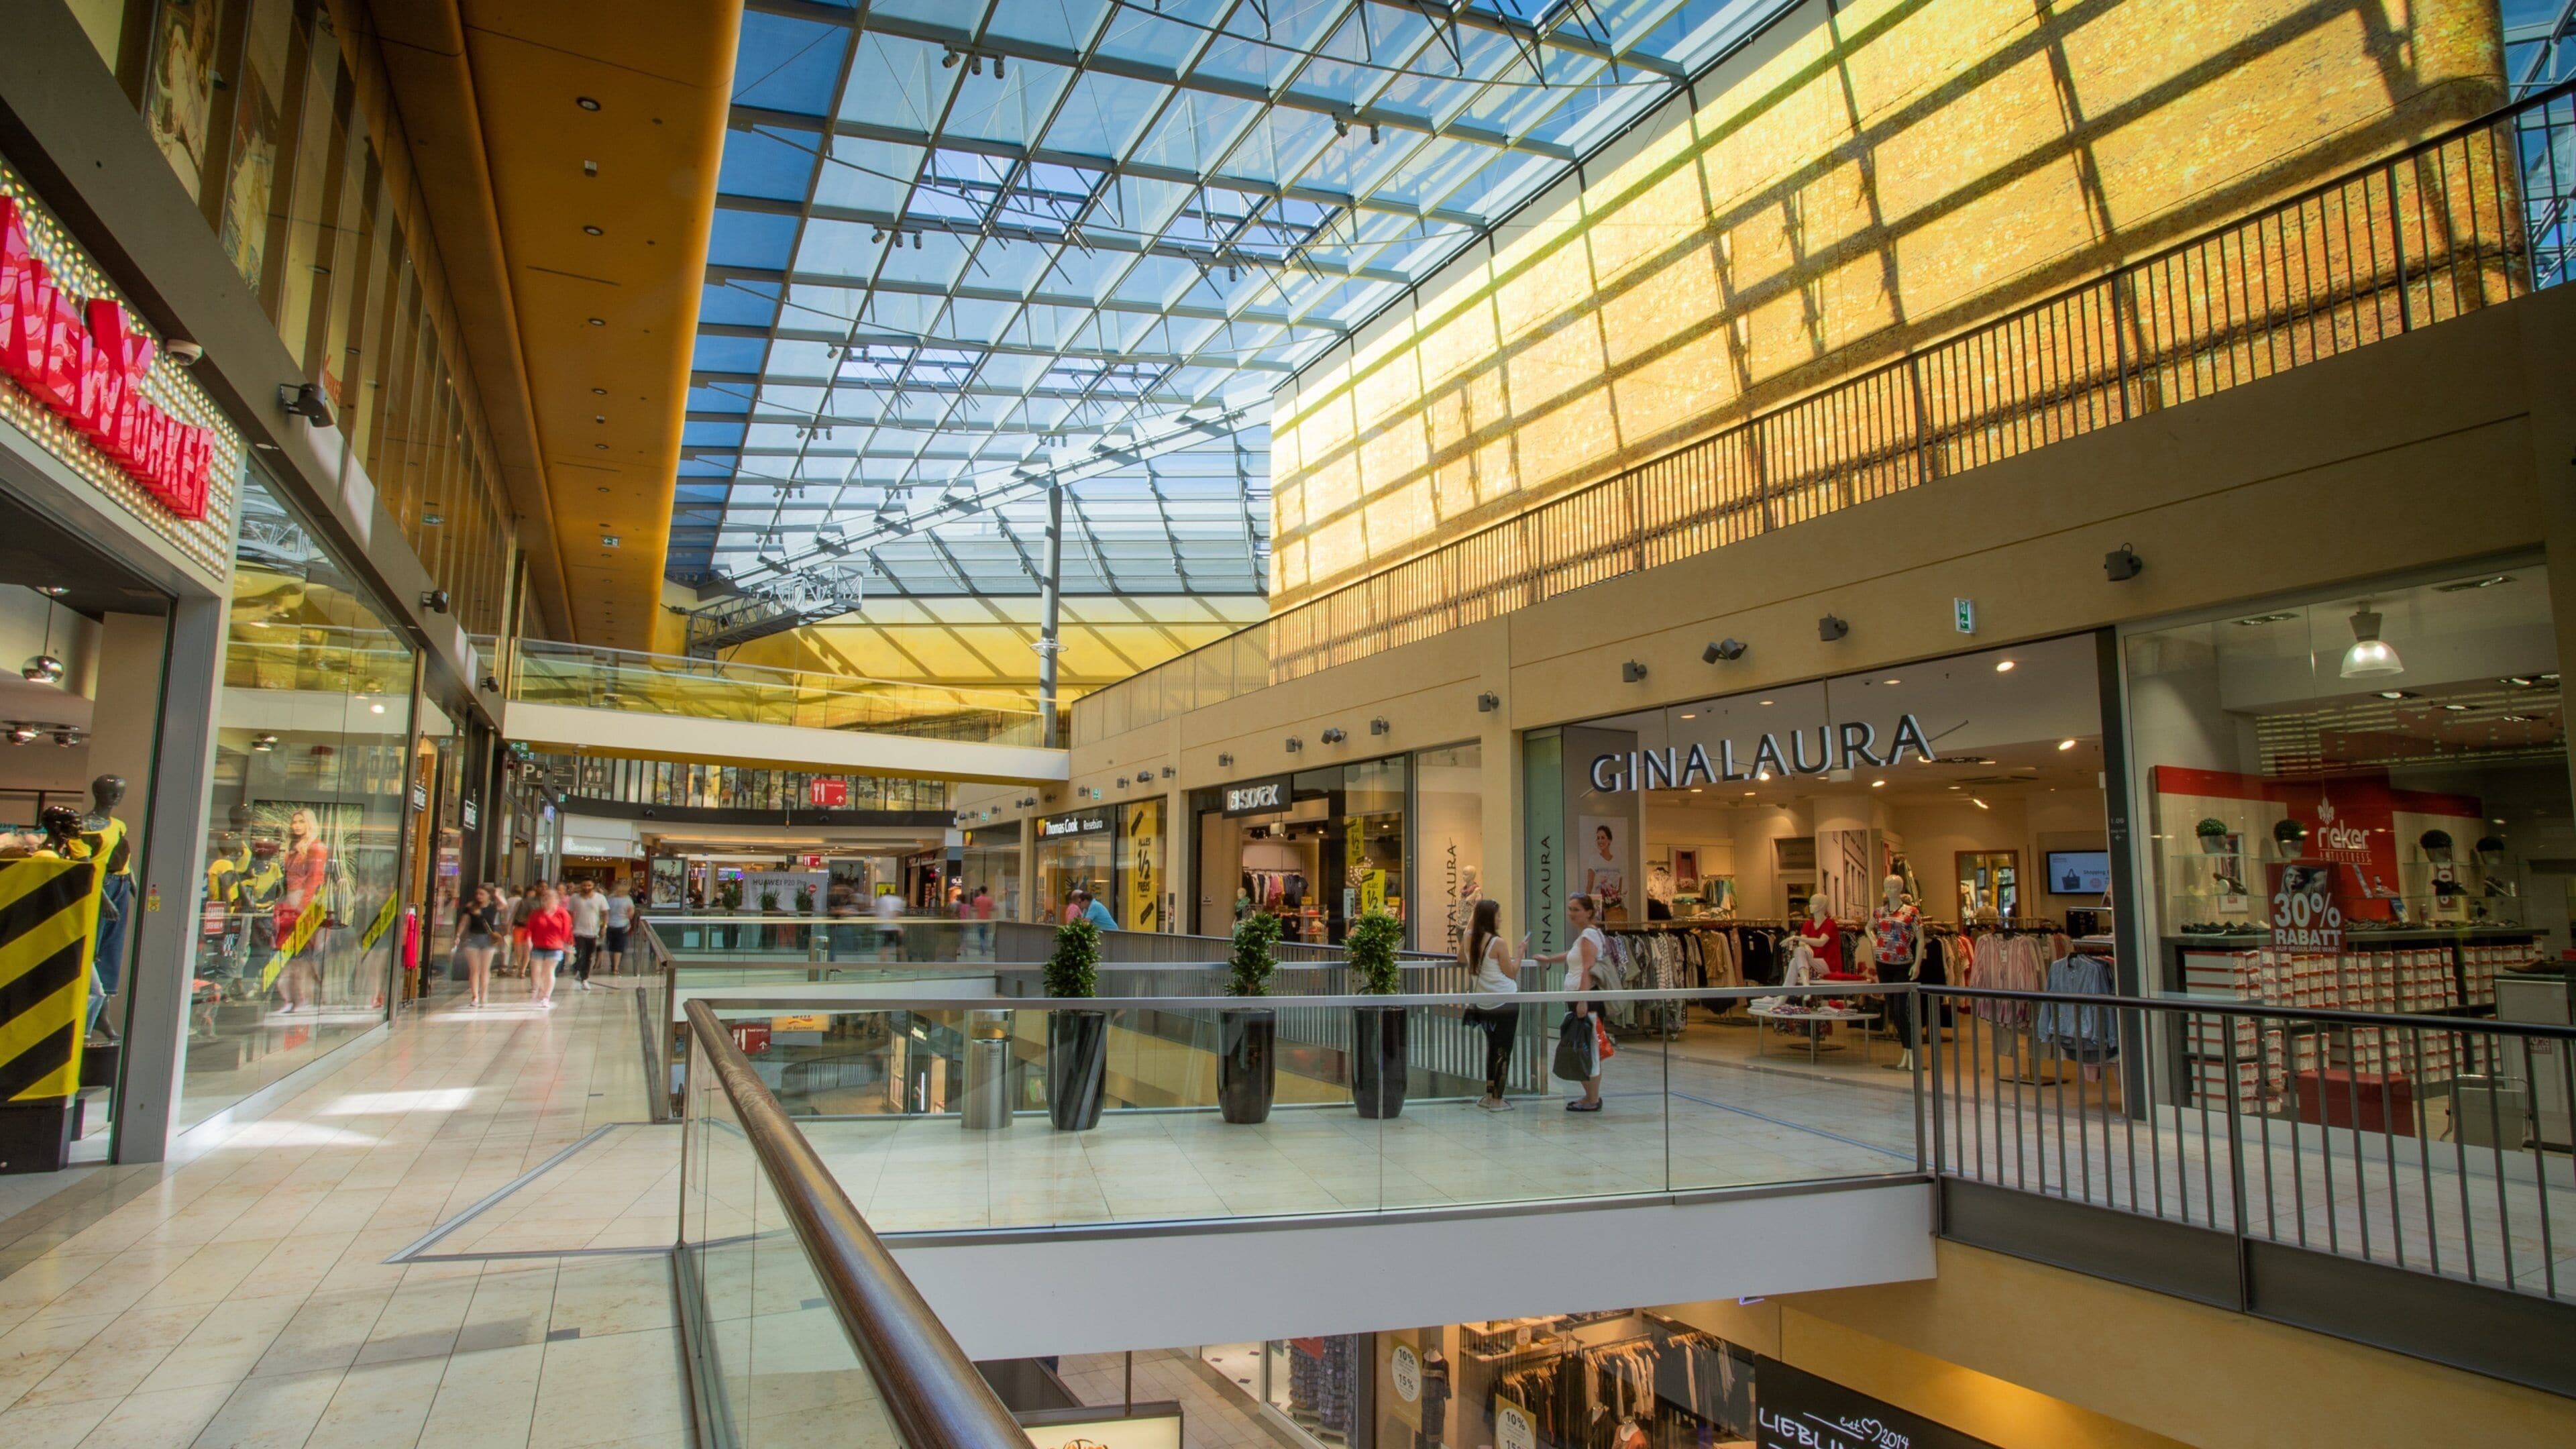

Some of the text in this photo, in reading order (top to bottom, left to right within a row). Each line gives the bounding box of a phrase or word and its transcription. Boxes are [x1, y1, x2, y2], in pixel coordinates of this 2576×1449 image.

[1590, 714, 1937, 792] GINALAURA
[523, 763, 535, 777] P
[1046, 821, 1065, 835] Thomas
[1065, 817, 1078, 833] Cook
[2318, 819, 2369, 849] rieker
[1138, 837, 1150, 847] ALLES
[2273, 892, 2341, 928] 30%
[2275, 928, 2341, 946] RABATT
[1399, 1349, 1414, 1365] 10%
[1506, 1411, 1525, 1431] 10%
[1507, 1440, 1523, 1449] 15
[1881, 1428, 1909, 1449] 2014
